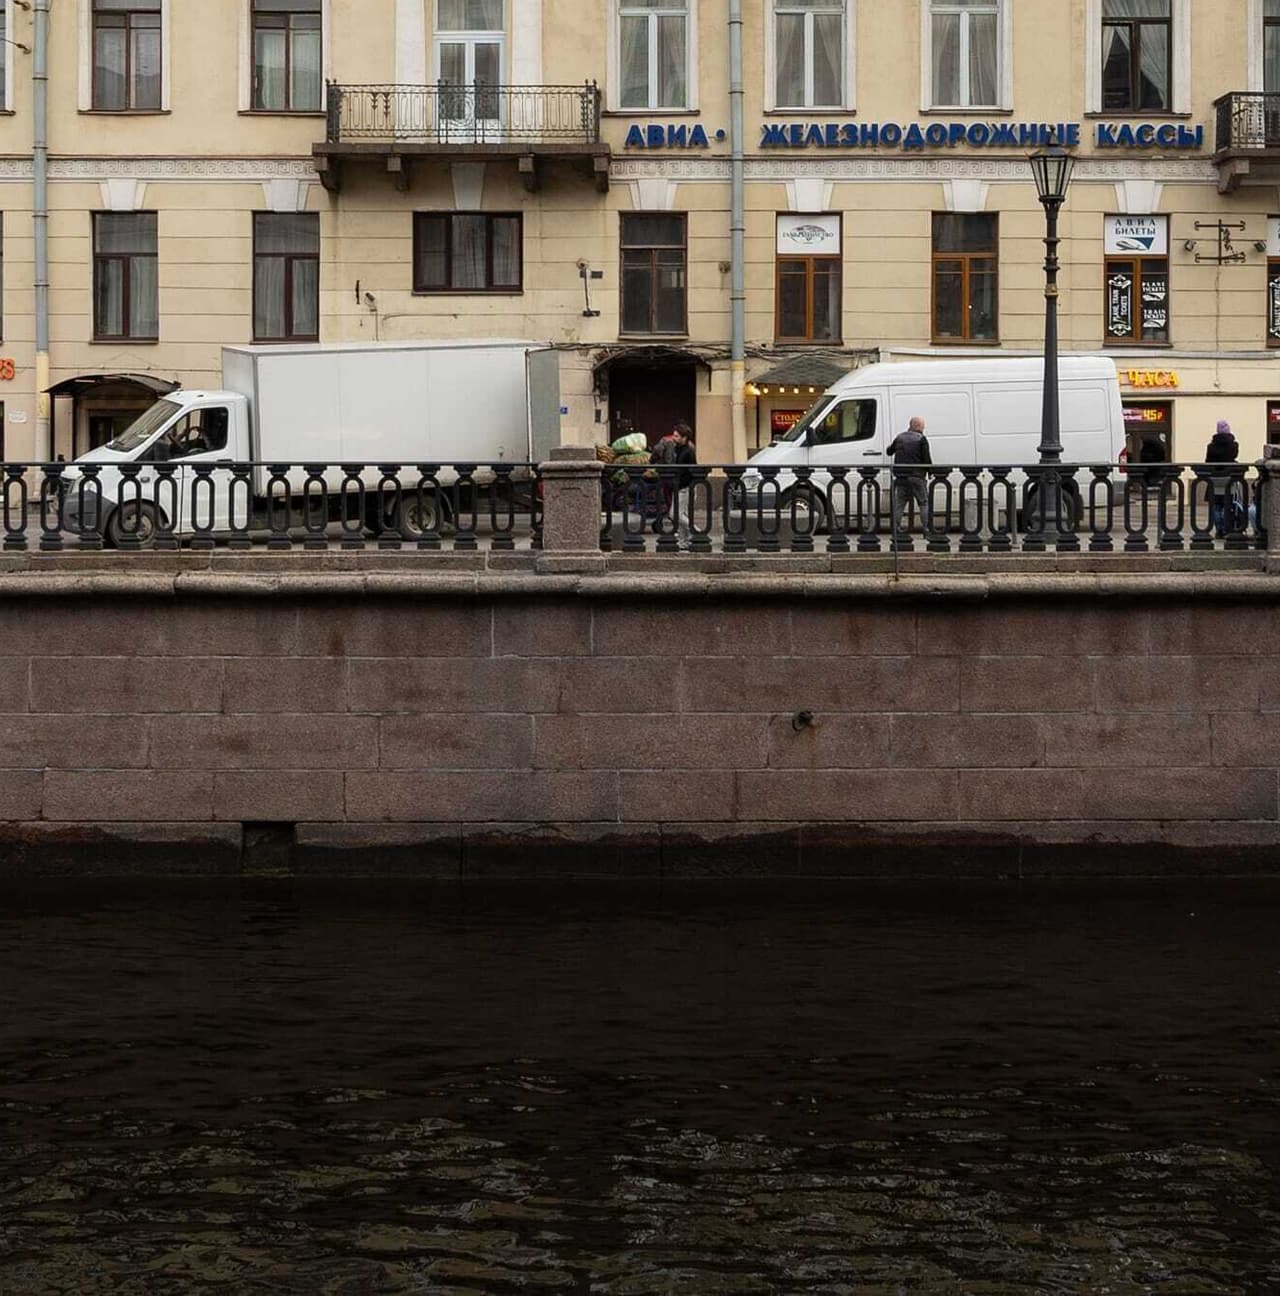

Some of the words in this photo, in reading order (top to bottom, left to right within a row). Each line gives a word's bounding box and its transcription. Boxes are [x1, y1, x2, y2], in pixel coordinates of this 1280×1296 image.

[625, 124, 709, 148] АВИА
[760, 123, 1080, 148] ЖЕЛЕЗНОДОРОЖНЫЕ
[1095, 123, 1204, 148] КАССЫ
[1115, 218, 1156, 226] АВИА
[1127, 369, 1179, 388] ЧАСА
